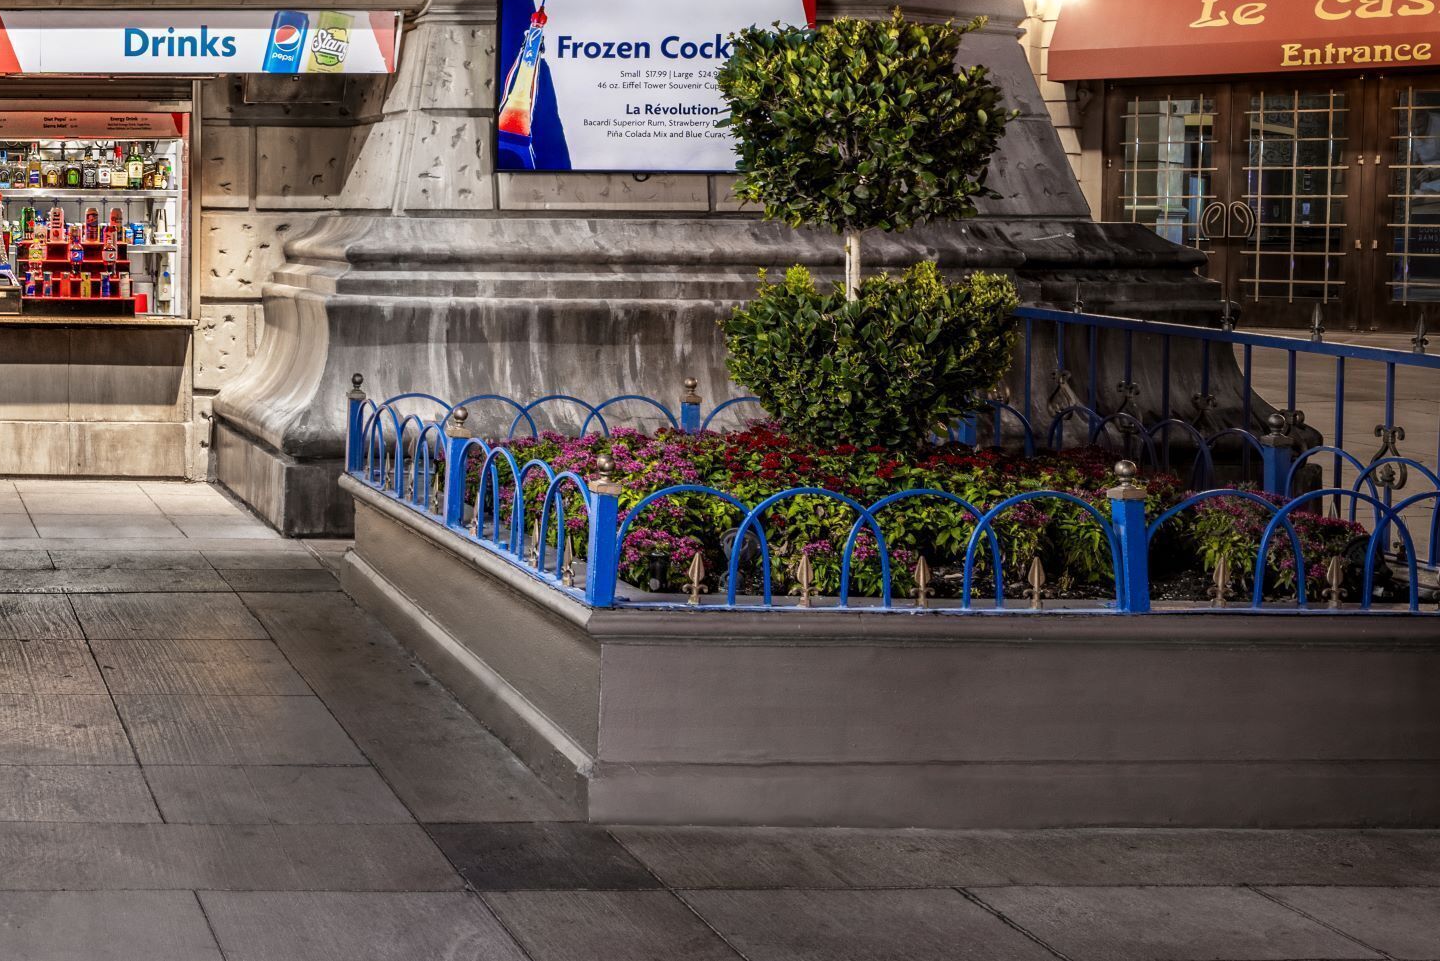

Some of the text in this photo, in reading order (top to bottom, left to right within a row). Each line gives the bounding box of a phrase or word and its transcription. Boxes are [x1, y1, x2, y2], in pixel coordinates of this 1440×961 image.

[1189, 0, 1268, 28] Le
[124, 24, 237, 58] Drinks
[557, 33, 737, 60] Frozen Cock
[272, 52, 294, 62] pepsi
[1280, 43, 1432, 67] Entrance
[620, 70, 641, 78] Small
[645, 70, 668, 79] $17.99
[673, 70, 694, 80] Large
[698, 70, 720, 79] $24.9
[597, 81, 607, 89] 46
[622, 81, 642, 89] Eiffel
[643, 81, 667, 90] Tower
[668, 82, 703, 90] Souvenir
[626, 102, 720, 116] La Révolution
[583, 119, 611, 127] Bacardi
[613, 119, 646, 129] Superior
[668, 119, 711, 130] Strawberry
[607, 130, 727, 139] Piña Colada Mix and Blue Curaç
